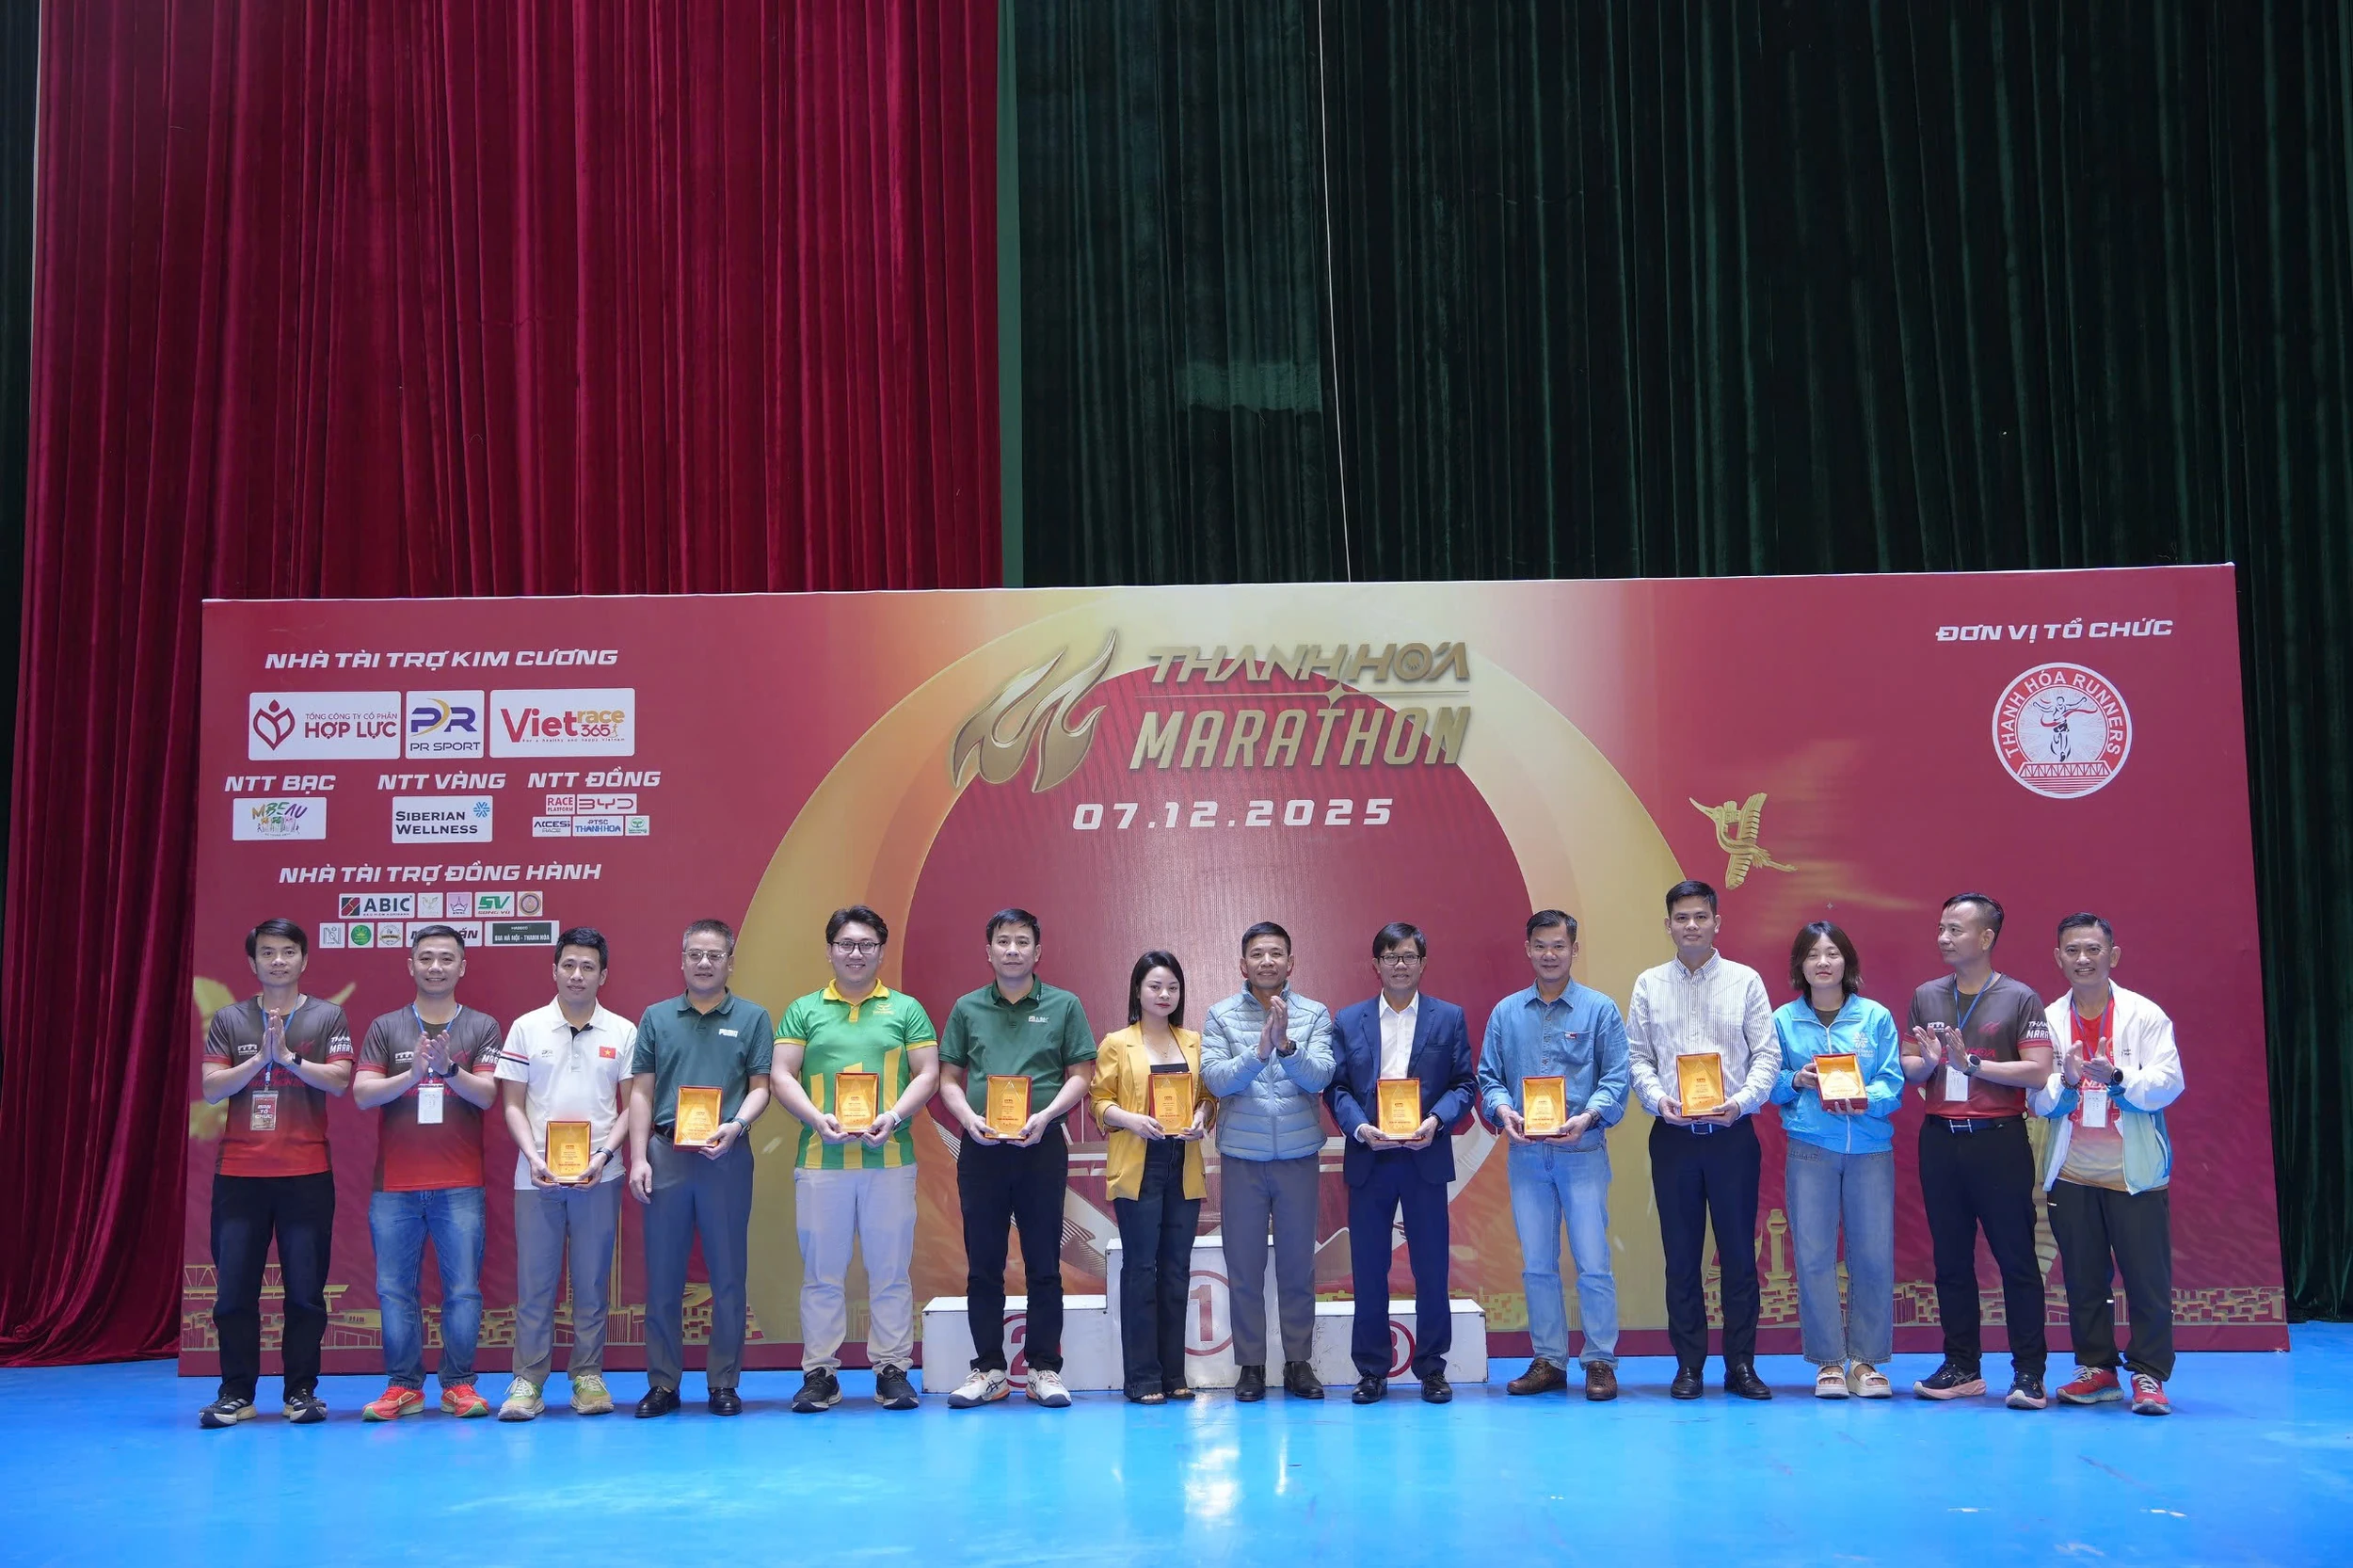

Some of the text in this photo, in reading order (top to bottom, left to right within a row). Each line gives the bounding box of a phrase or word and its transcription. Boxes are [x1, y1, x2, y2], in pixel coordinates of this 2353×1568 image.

[1935, 617, 2173, 644] ĐƠN VỊ TỔ CHỨC
[264, 648, 618, 671] NHÀ TÀI TRỢ KIM CƯƠNG
[410, 706, 478, 733] PR
[2001, 670, 2123, 759] THANH HÓA RUNNERS
[305, 721, 397, 739] HỢP LỰC
[581, 724, 611, 737] 365
[1129, 706, 1472, 770] MARATHON
[410, 742, 481, 751] PR SPORT
[224, 775, 336, 794] NTT BẠC
[377, 770, 506, 791] NTT VÀNG
[527, 765, 662, 789] NTT ĐỒNG
[547, 797, 573, 806] RACE
[578, 798, 634, 810] BYD
[1072, 798, 1393, 830] 07.12.2025
[279, 860, 602, 886] NHÀ TÀI TRỢ ĐỒNG HÀNH
[363, 897, 410, 913] ABIC
[478, 896, 511, 909] SV
